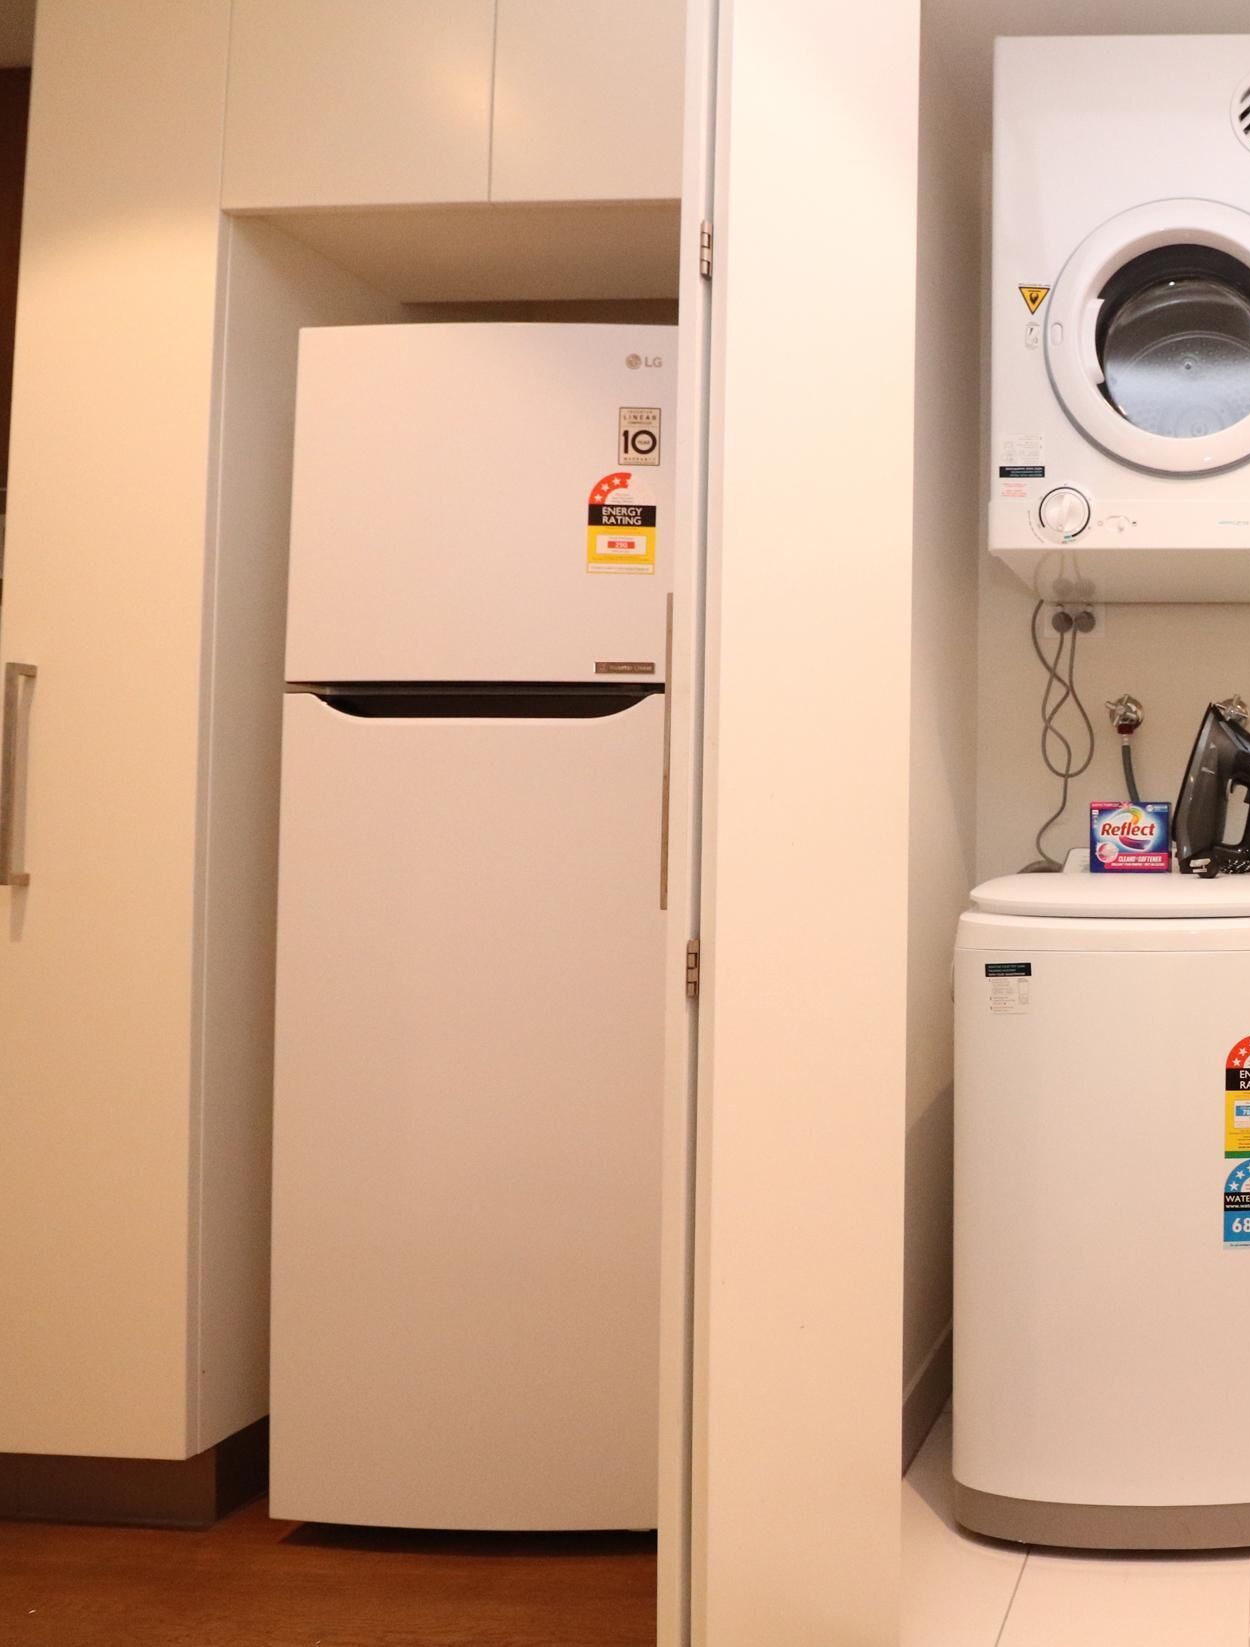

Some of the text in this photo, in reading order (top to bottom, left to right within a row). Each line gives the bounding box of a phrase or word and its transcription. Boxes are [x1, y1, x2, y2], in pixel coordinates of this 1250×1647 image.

[644, 356, 663, 368] LG
[622, 429, 657, 455] 10
[602, 507, 643, 516] ENERGY
[602, 516, 642, 525] RATING
[1101, 821, 1156, 836] Reflect
